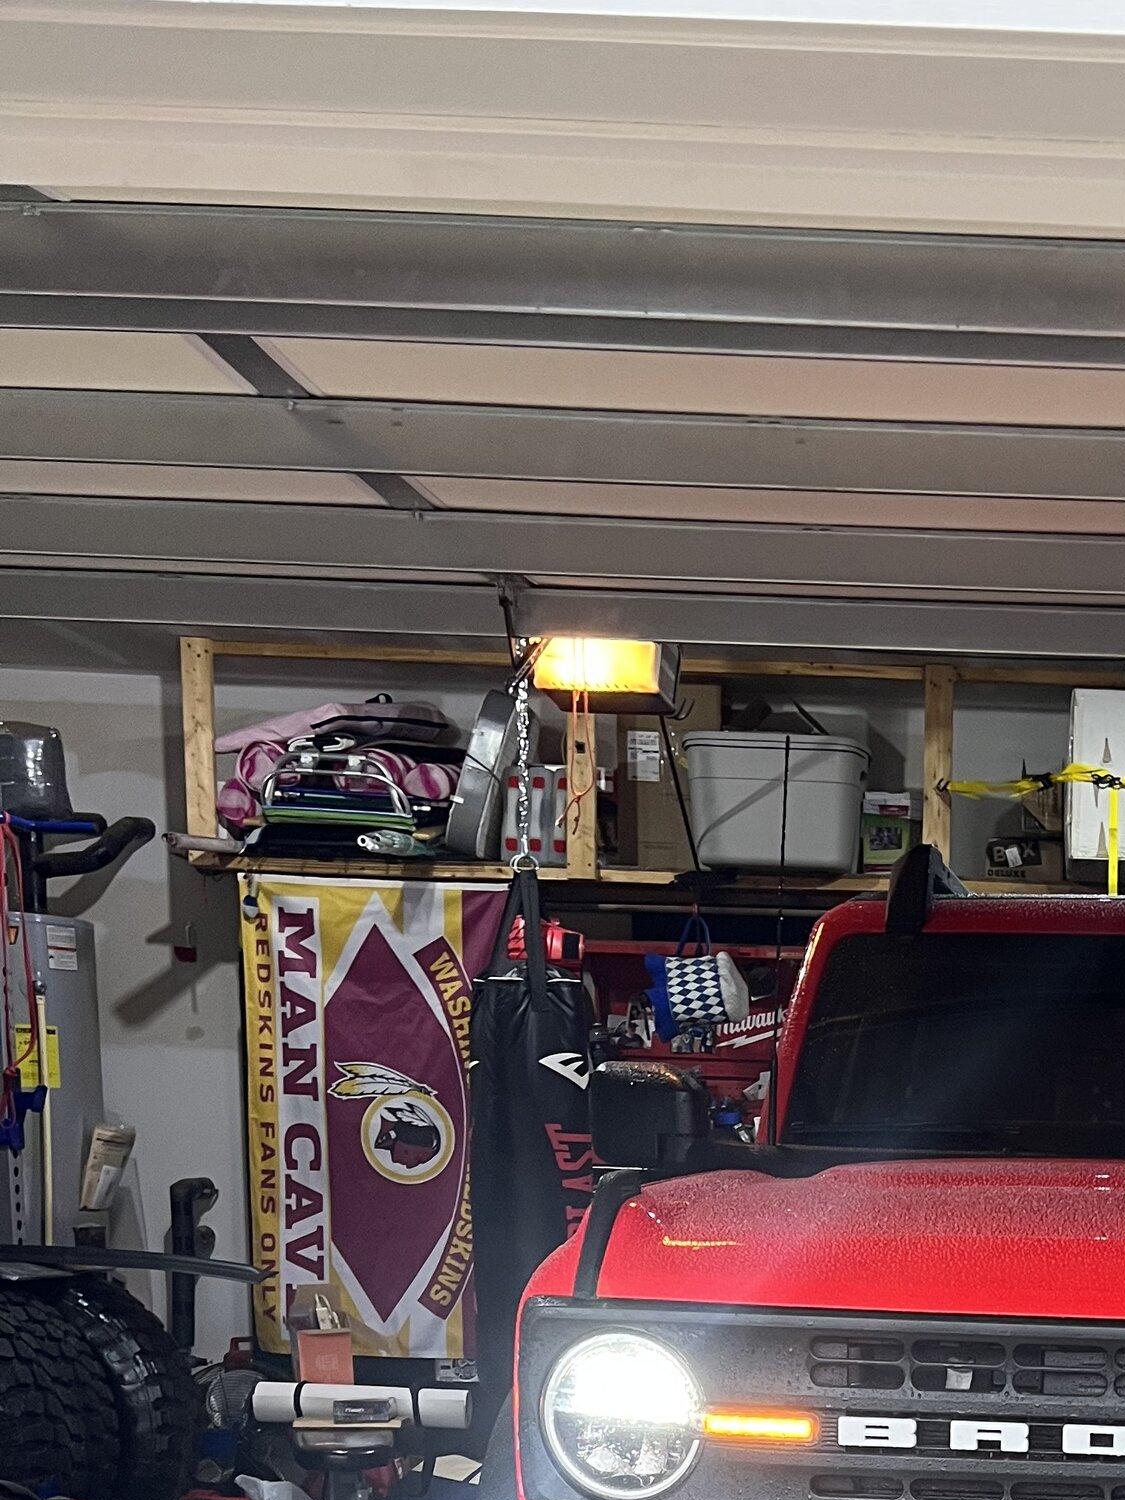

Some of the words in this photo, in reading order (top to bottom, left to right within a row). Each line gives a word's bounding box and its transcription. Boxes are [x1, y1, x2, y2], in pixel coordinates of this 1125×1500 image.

[993, 843, 1036, 862] BX
[254, 913, 275, 1103] REDSKINS
[277, 906, 319, 1102] MAN
[260, 1121, 276, 1214] FANS
